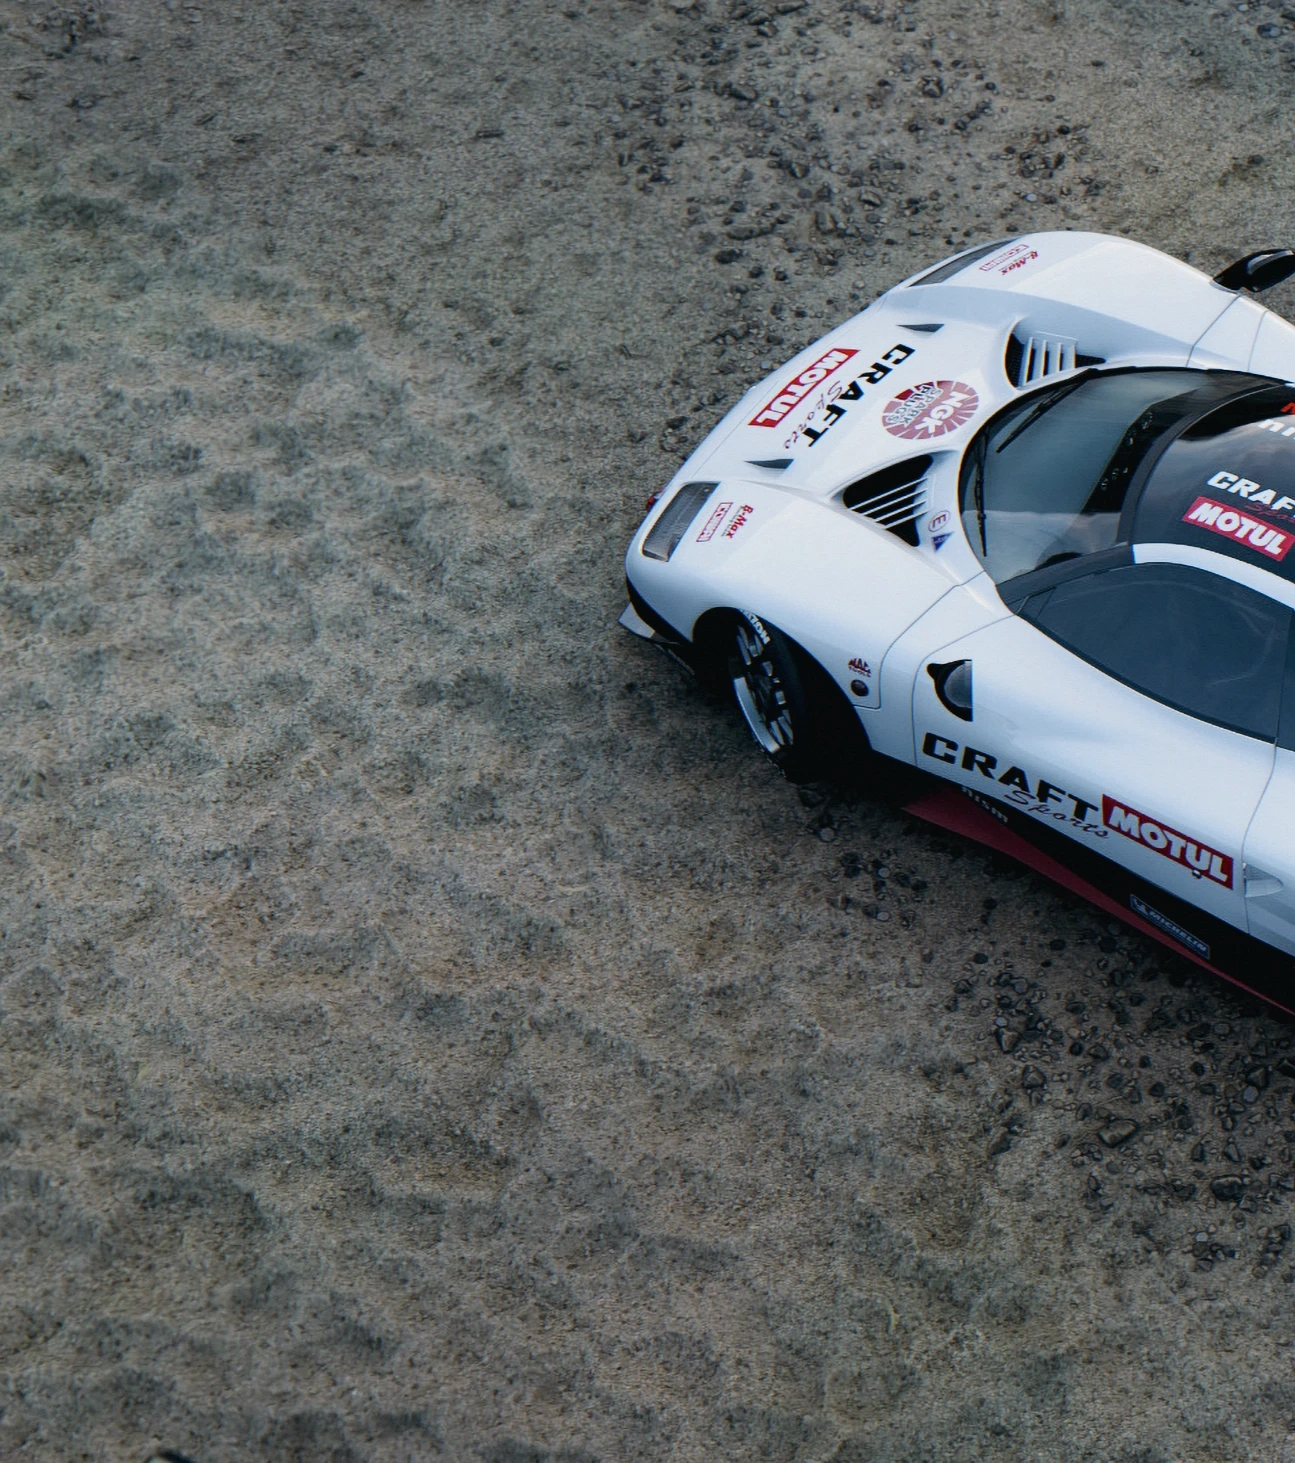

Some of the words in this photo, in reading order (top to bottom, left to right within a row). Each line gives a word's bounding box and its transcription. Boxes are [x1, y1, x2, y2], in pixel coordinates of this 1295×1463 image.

[753, 349, 851, 426] MOTUL
[802, 344, 915, 447] CRAFT
[887, 385, 932, 424] PLUGS
[902, 388, 943, 425] SPARK
[914, 391, 971, 434] NGK
[1188, 502, 1289, 556] MOTUL
[922, 732, 1099, 822] CRAFT
[1003, 789, 1109, 840] Sports
[1107, 805, 1229, 883] MOTUL
